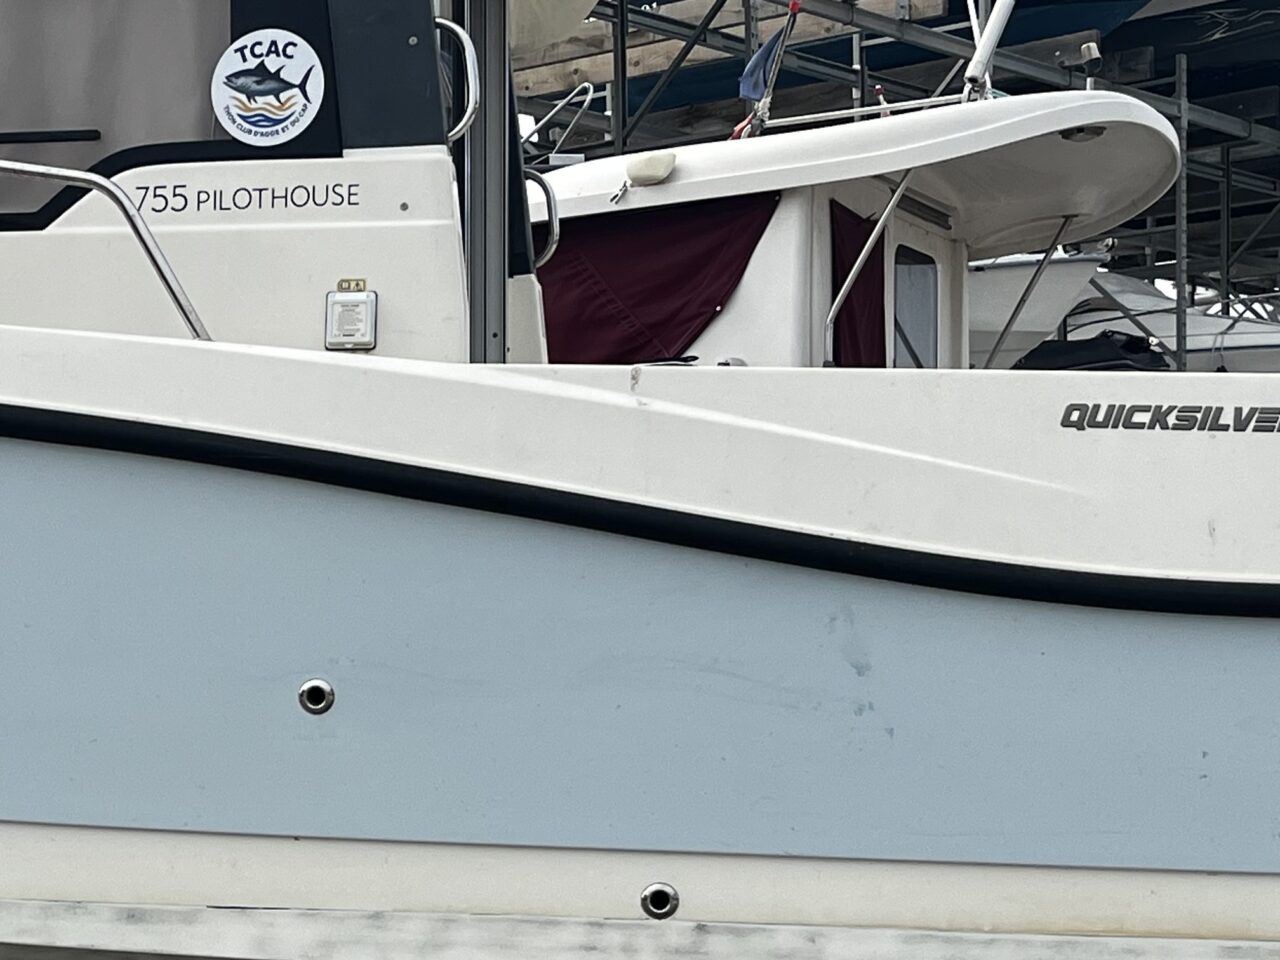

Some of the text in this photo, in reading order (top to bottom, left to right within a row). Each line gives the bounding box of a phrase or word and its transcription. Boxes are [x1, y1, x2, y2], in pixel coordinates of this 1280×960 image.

[234, 39, 298, 63] TCAC
[237, 123, 253, 136] CLUB
[282, 124, 290, 133] ET
[290, 117, 300, 127] DU
[298, 103, 308, 117] CAP
[136, 183, 360, 213] 755 PILOTHOUSE
[1060, 403, 1280, 432] QUICKSILVE
